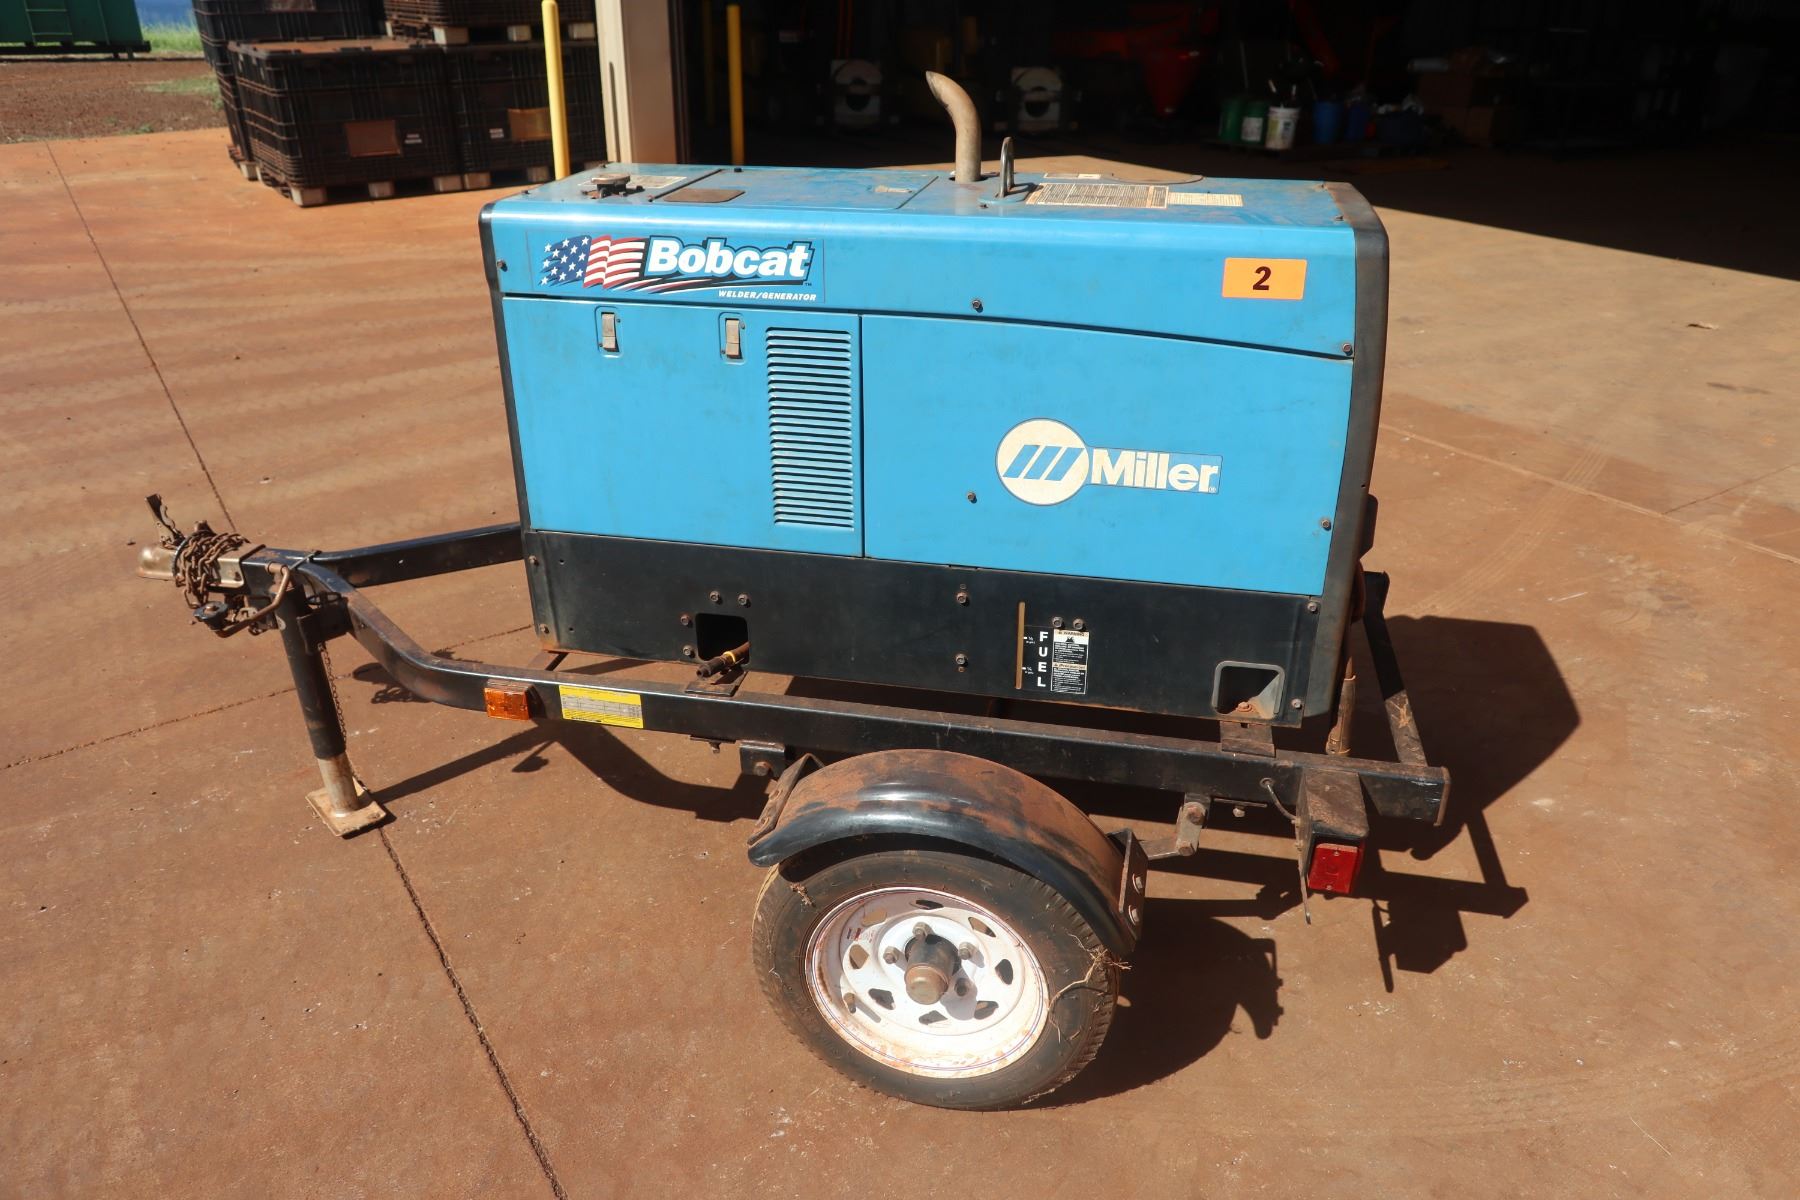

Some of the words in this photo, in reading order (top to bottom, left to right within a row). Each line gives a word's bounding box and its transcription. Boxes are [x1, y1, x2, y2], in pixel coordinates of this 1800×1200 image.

[648, 238, 811, 279] Bobcat
[1252, 265, 1272, 291] 2
[718, 289, 817, 302] WELDER/GENERATOR
[1090, 447, 1219, 493] Miller
